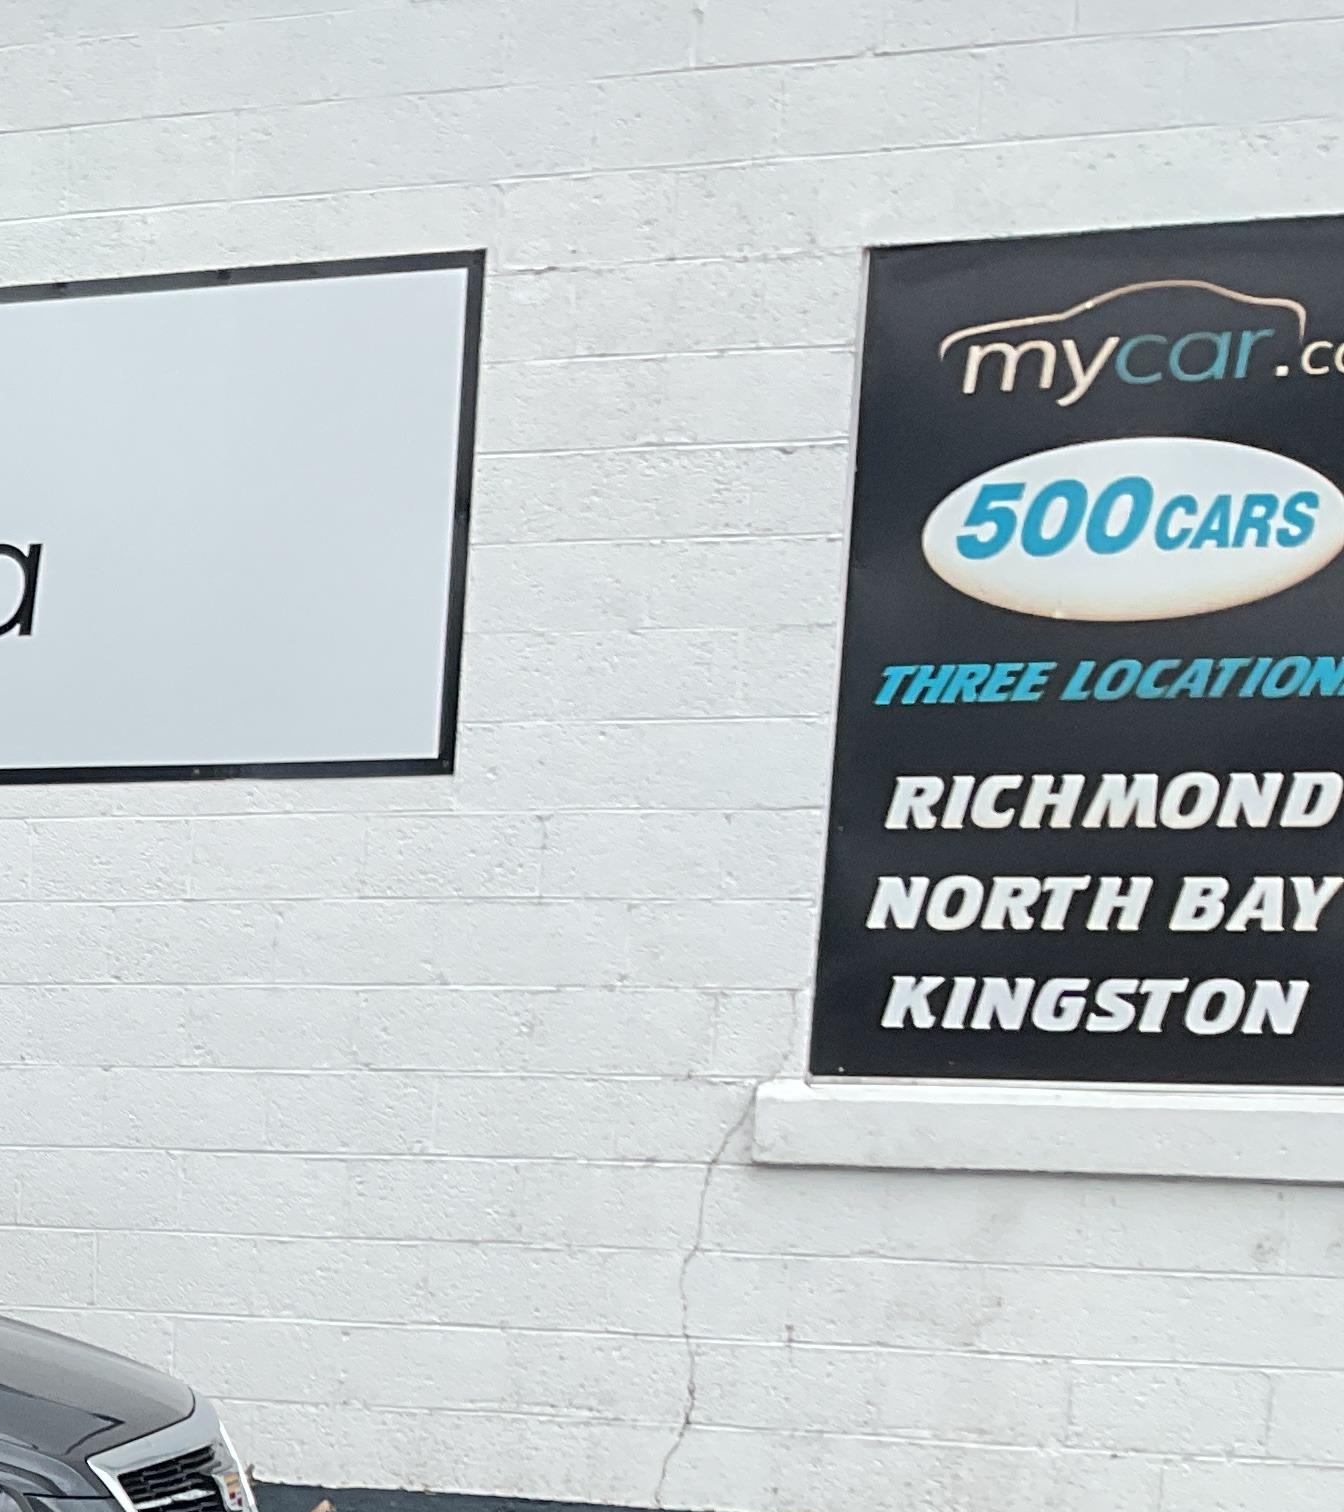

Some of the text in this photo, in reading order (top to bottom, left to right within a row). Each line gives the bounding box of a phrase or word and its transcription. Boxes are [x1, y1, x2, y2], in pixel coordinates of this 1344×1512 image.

[956, 476, 1319, 560] 500 CARS
[874, 655, 1344, 706] THREE LOCATION
[885, 772, 1344, 830] RICHMOND
[866, 875, 1344, 932] NORTH BAY
[880, 975, 1310, 1036] KINGSTON
